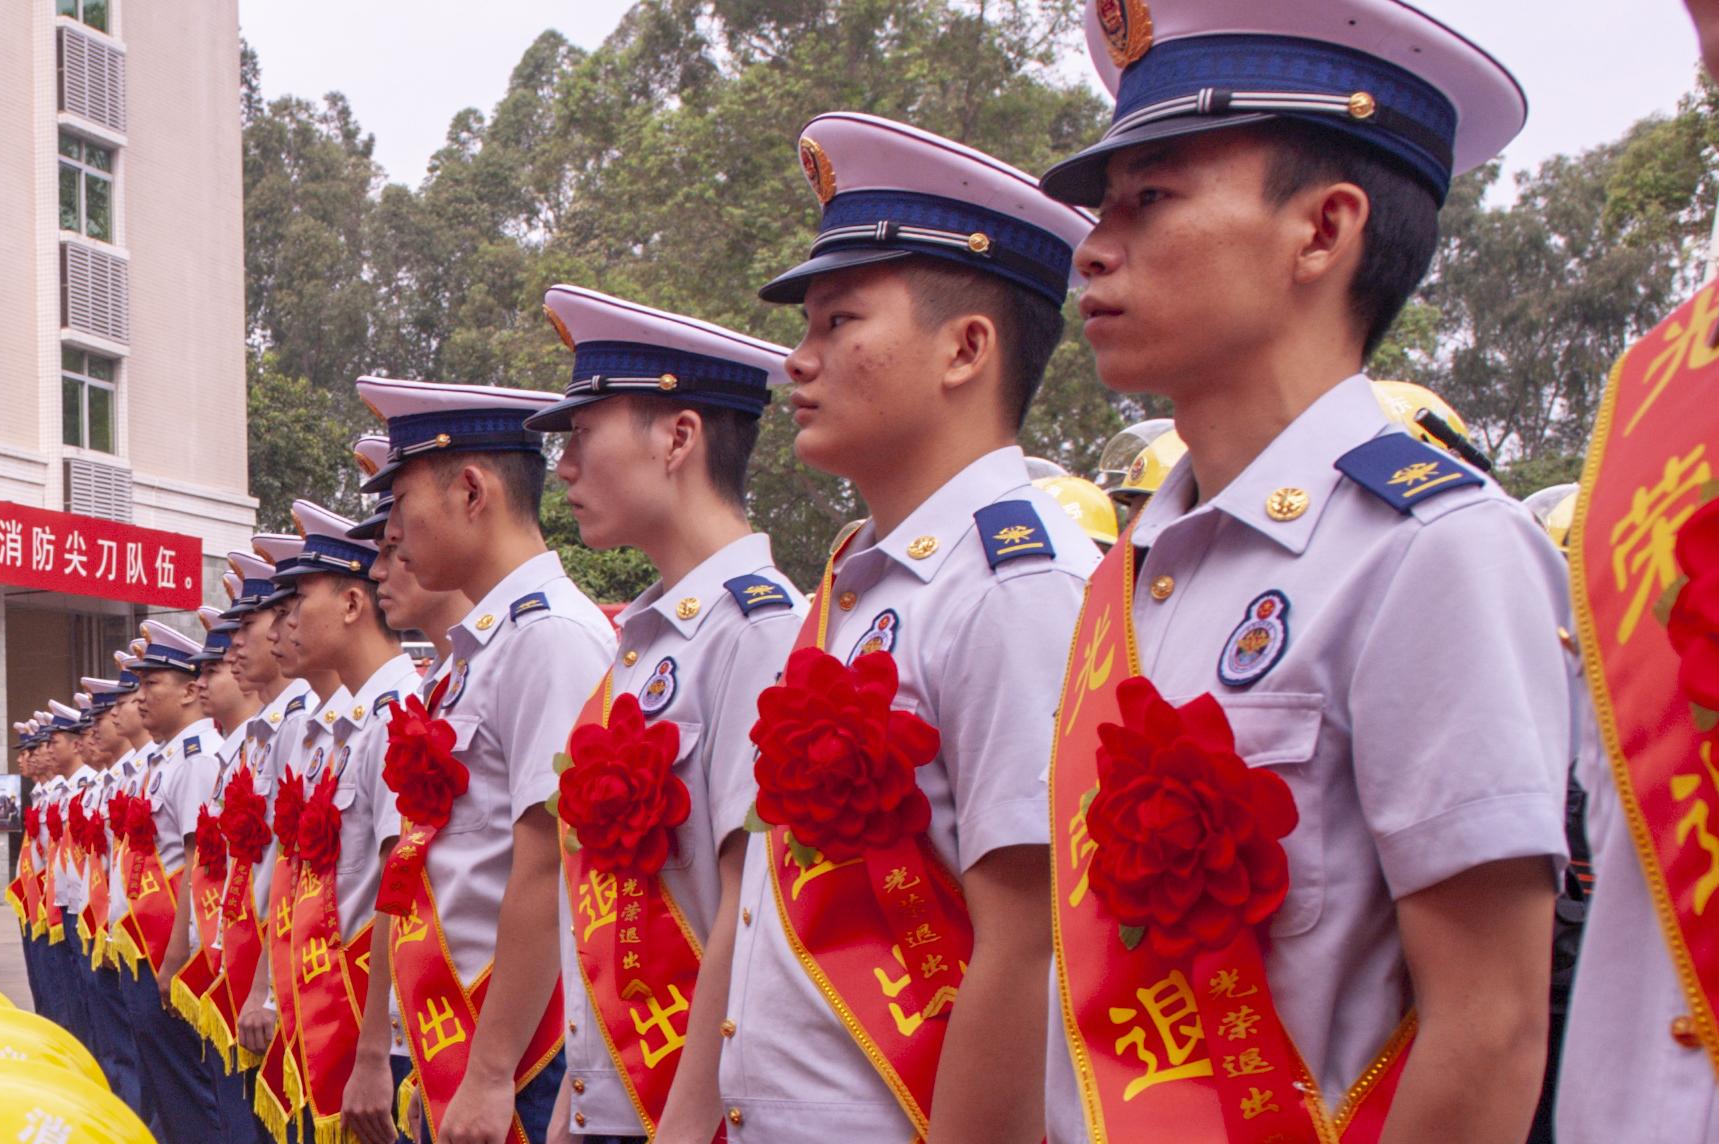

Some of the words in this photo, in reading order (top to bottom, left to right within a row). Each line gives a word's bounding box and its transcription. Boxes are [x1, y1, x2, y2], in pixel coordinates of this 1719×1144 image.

[619, 877, 644, 970] 光荣退出
[1207, 968, 1280, 1120] 光荣退出
